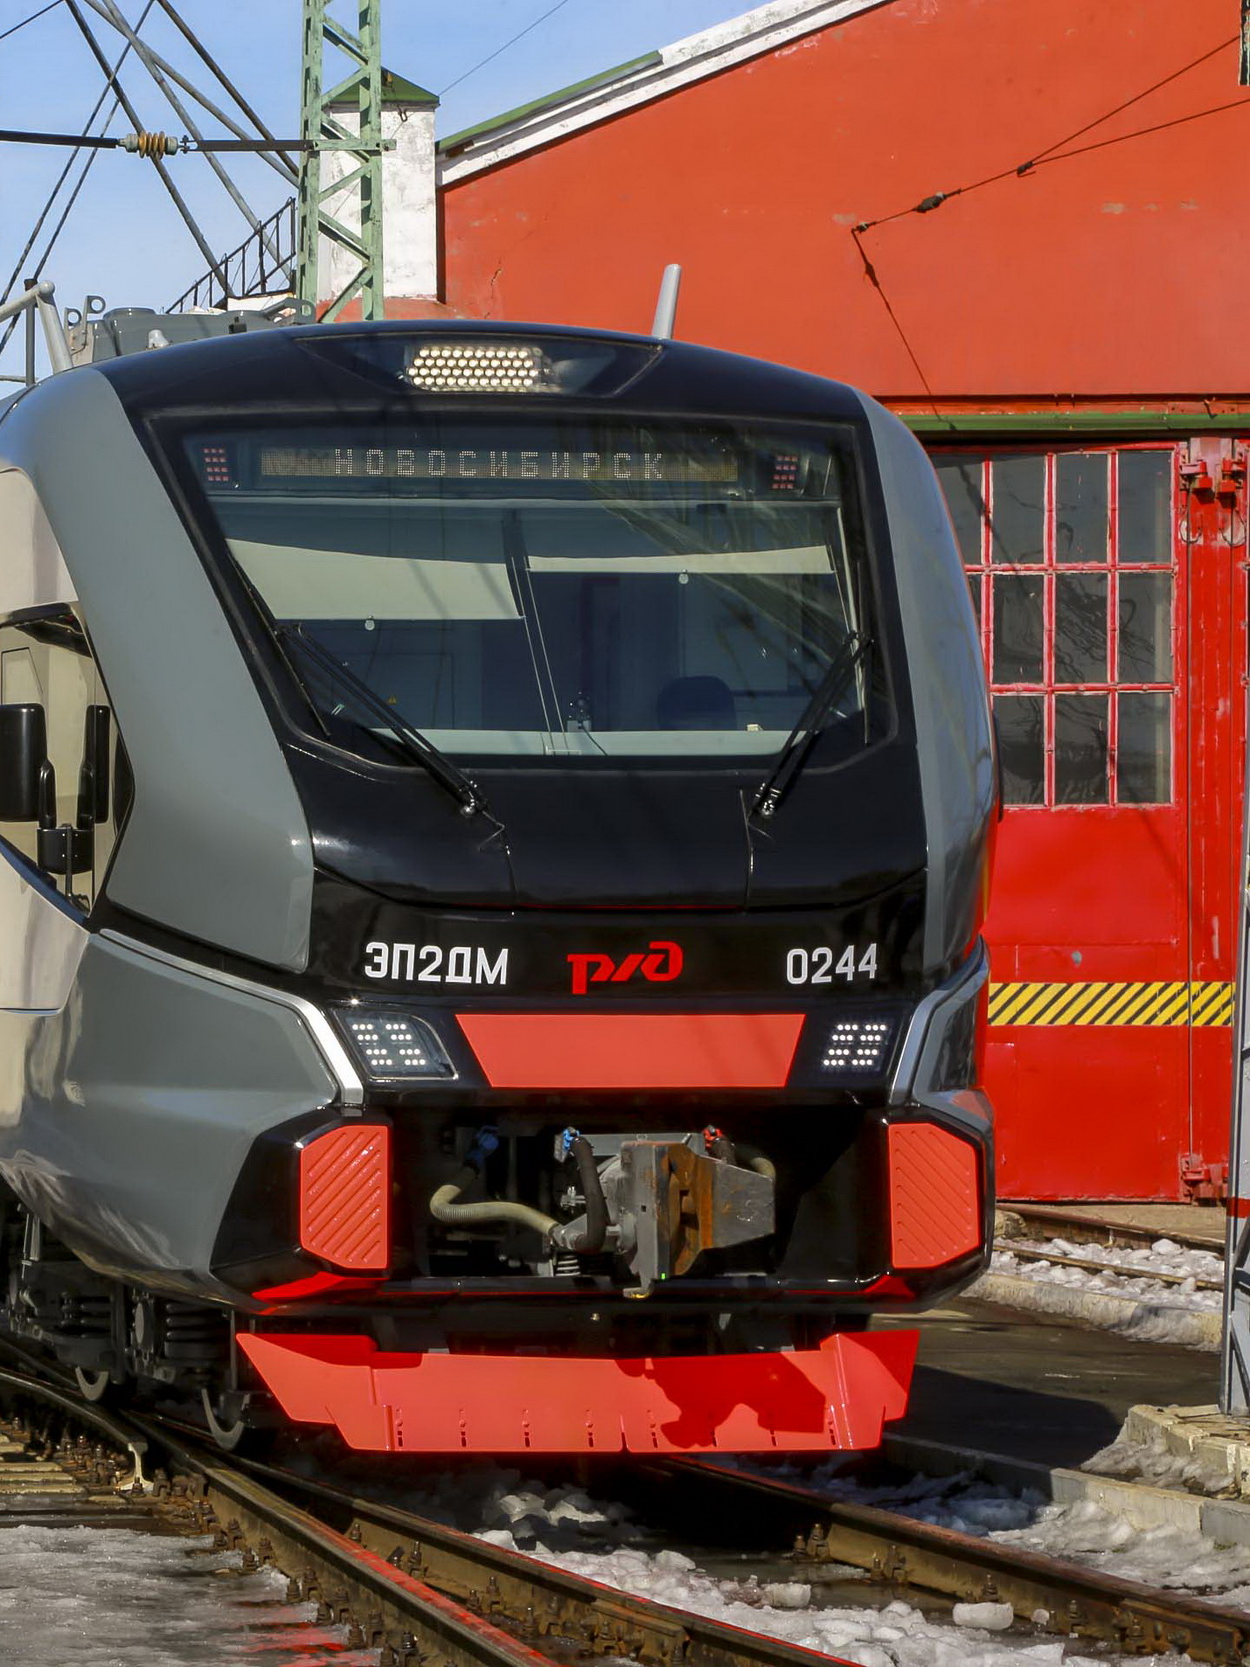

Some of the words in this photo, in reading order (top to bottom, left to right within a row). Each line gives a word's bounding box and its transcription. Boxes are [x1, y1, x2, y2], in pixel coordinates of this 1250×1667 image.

[335, 449, 662, 479] НОВОСИБИРСК
[365, 941, 509, 985] ЭП2ДМ
[786, 943, 878, 985] 0244
